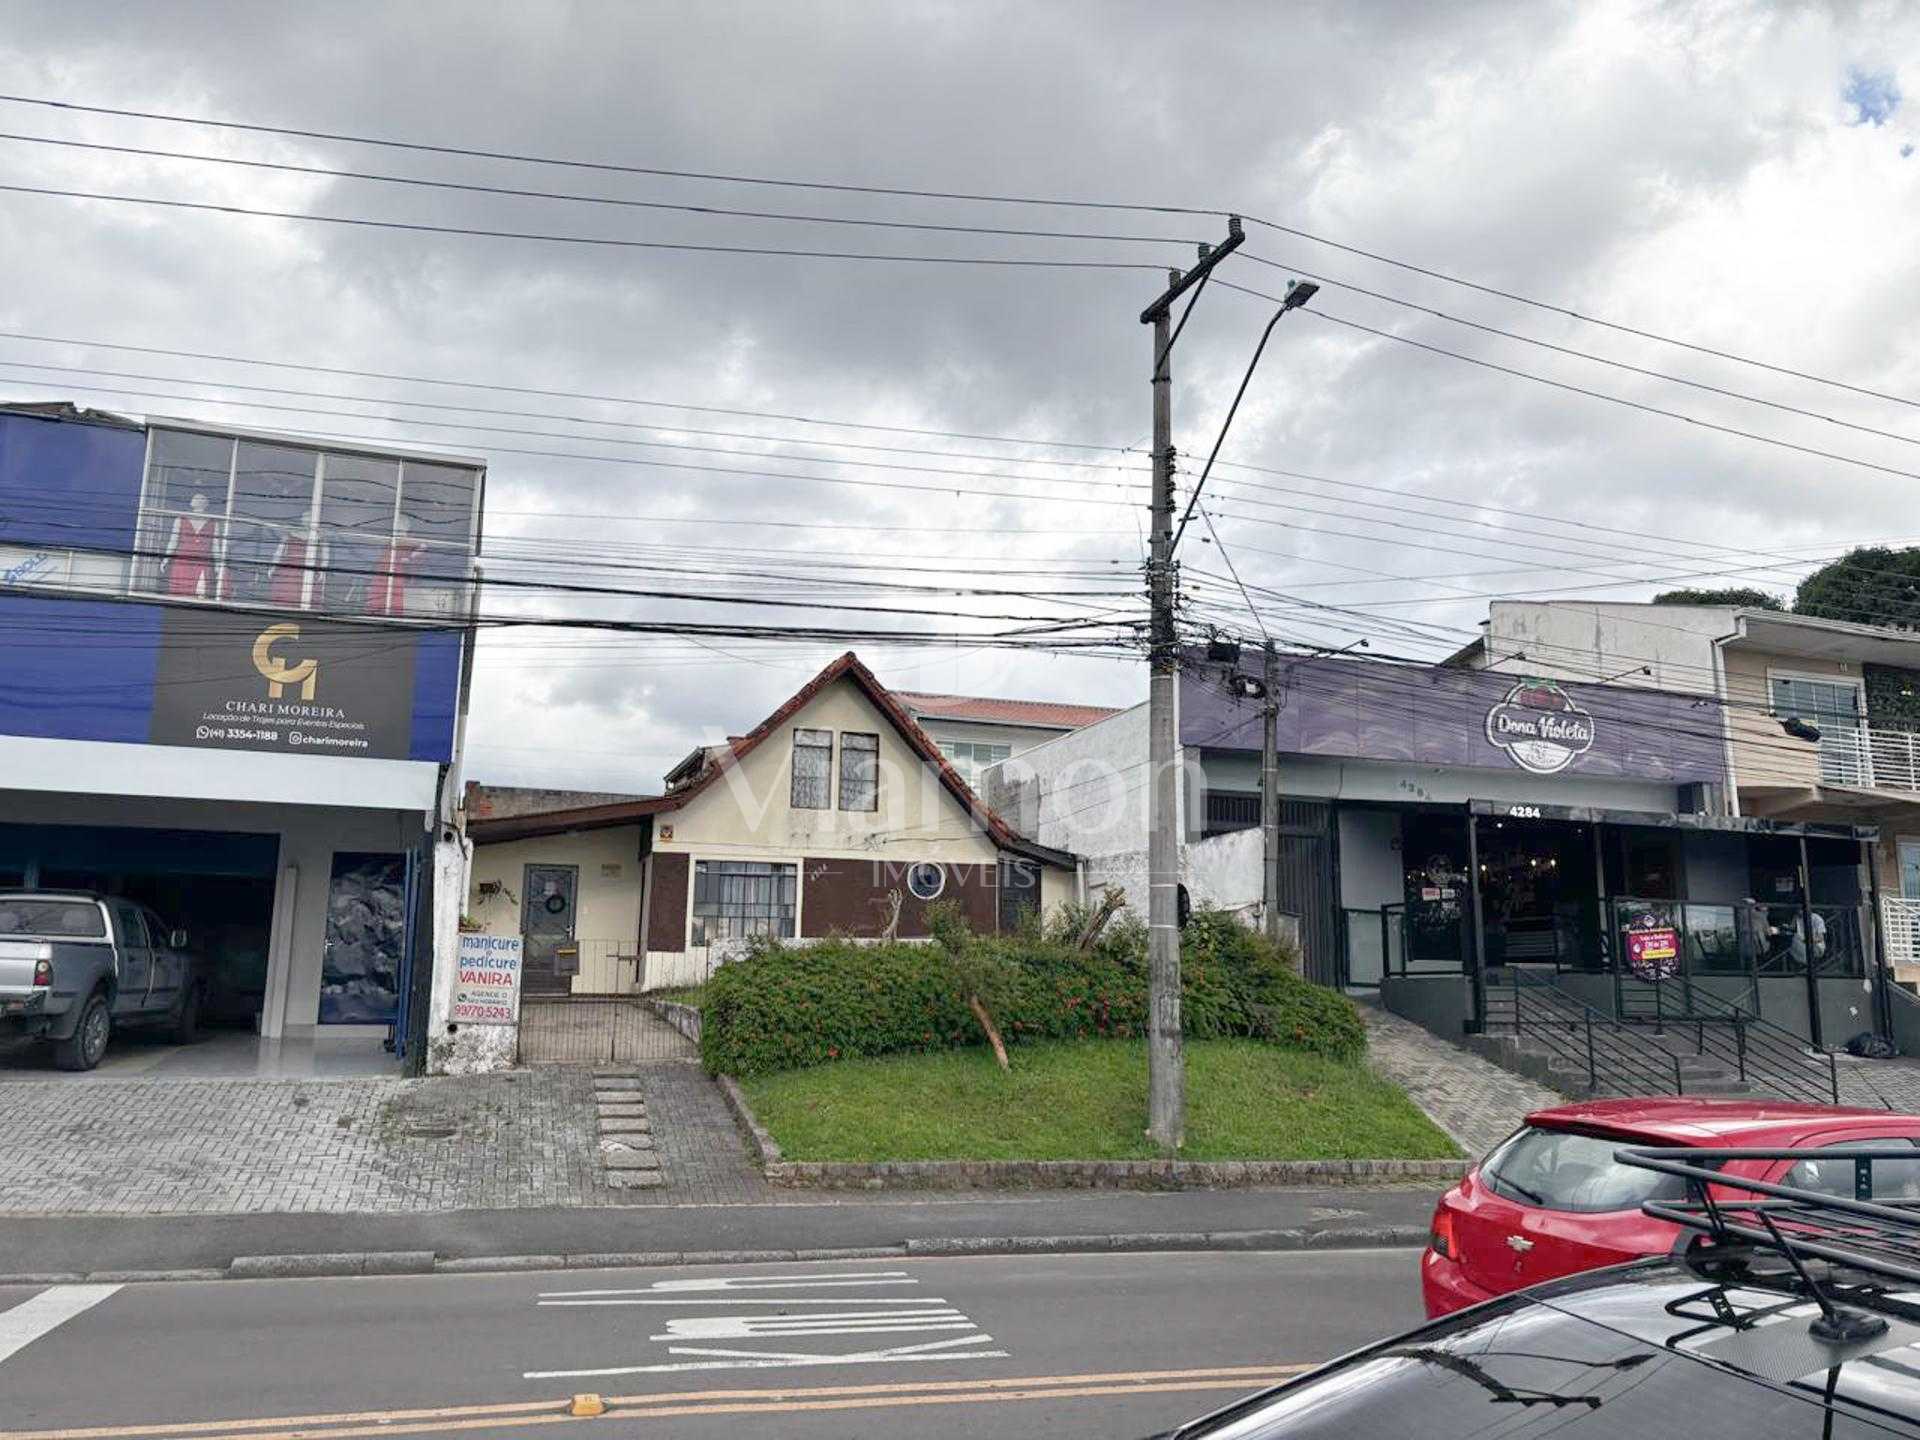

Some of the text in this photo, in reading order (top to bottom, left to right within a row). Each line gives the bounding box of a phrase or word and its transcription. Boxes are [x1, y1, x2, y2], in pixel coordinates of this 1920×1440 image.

[225, 700, 345, 719] CHARI MOREIRA
[239, 714, 250, 722] de
[1497, 713, 1588, 740] Dona Violeta
[227, 728, 278, 741] 3354-1188
[1509, 806, 1541, 819] 4284
[463, 935, 519, 951] manicure
[460, 955, 517, 970] pedicure
[459, 970, 512, 986] VANIRA
